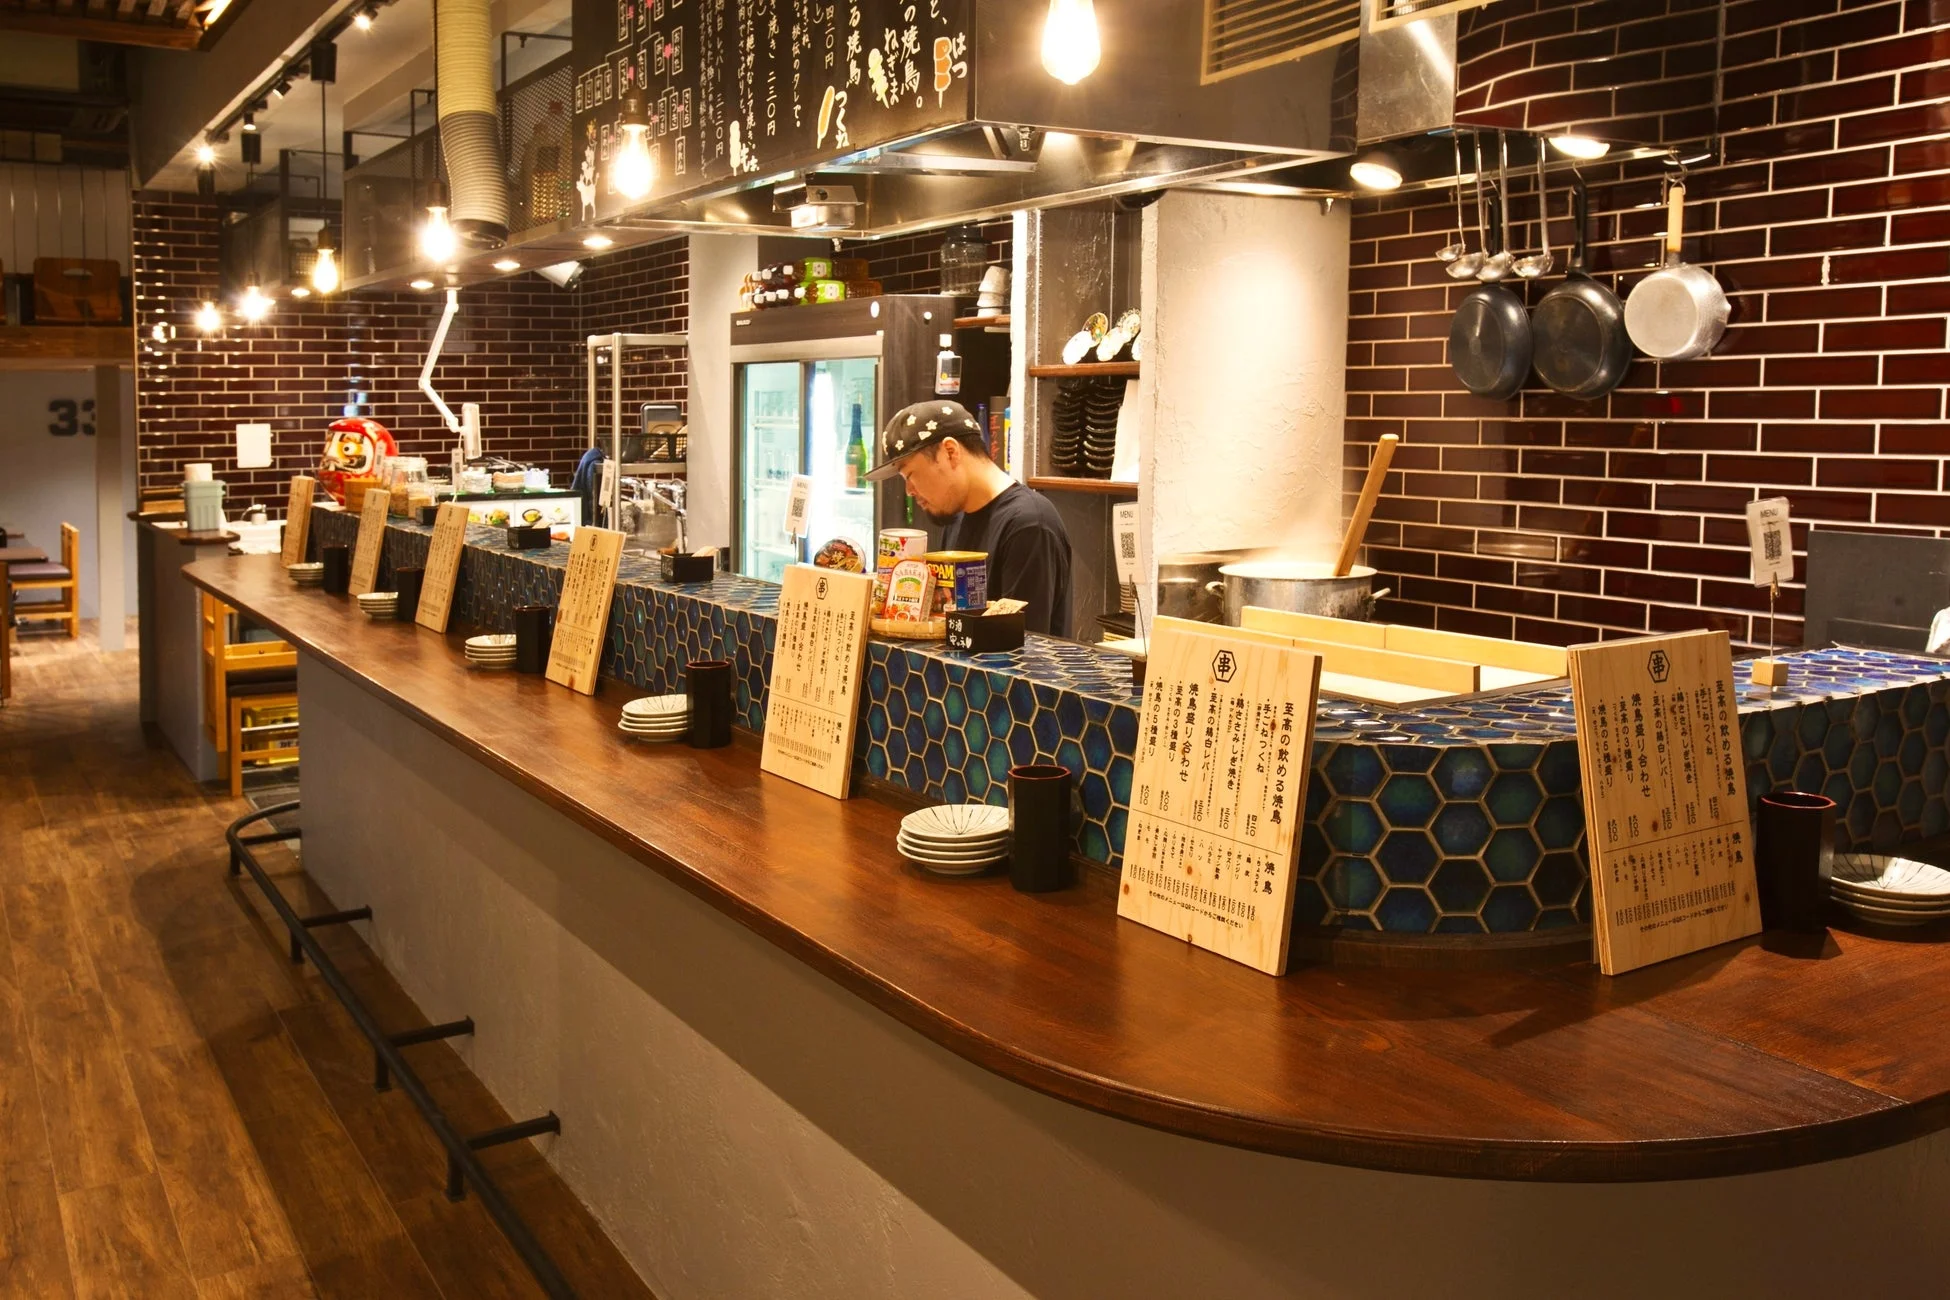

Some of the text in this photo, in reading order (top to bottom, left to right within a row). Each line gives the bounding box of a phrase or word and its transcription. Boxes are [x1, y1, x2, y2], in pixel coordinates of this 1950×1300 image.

[824, 5, 836, 70] 四二〇円
[846, 0, 862, 88] る焼鳥
[884, 27, 900, 105] ねぎま
[900, 0, 923, 108] の焼鳥。
[952, 31, 968, 79] はつ
[766, 71, 778, 136] 二三〇円
[834, 90, 850, 150] つくね
[1120, 510, 1134, 518] MENU
[1759, 508, 1779, 519] MENU
[1217, 653, 1232, 679] 串
[1651, 654, 1666, 680] 串
[1179, 683, 1199, 783] 焼鳥盛り合わせ
[1269, 702, 1295, 825] 至高の飲める焼鳥
[1631, 693, 1651, 798] 焼鳥盛り合わせ
[1715, 680, 1736, 796] 至高の飲める焼鳥
[1262, 861, 1276, 895] 焼鳥
[1732, 831, 1744, 864] 焼鳥
